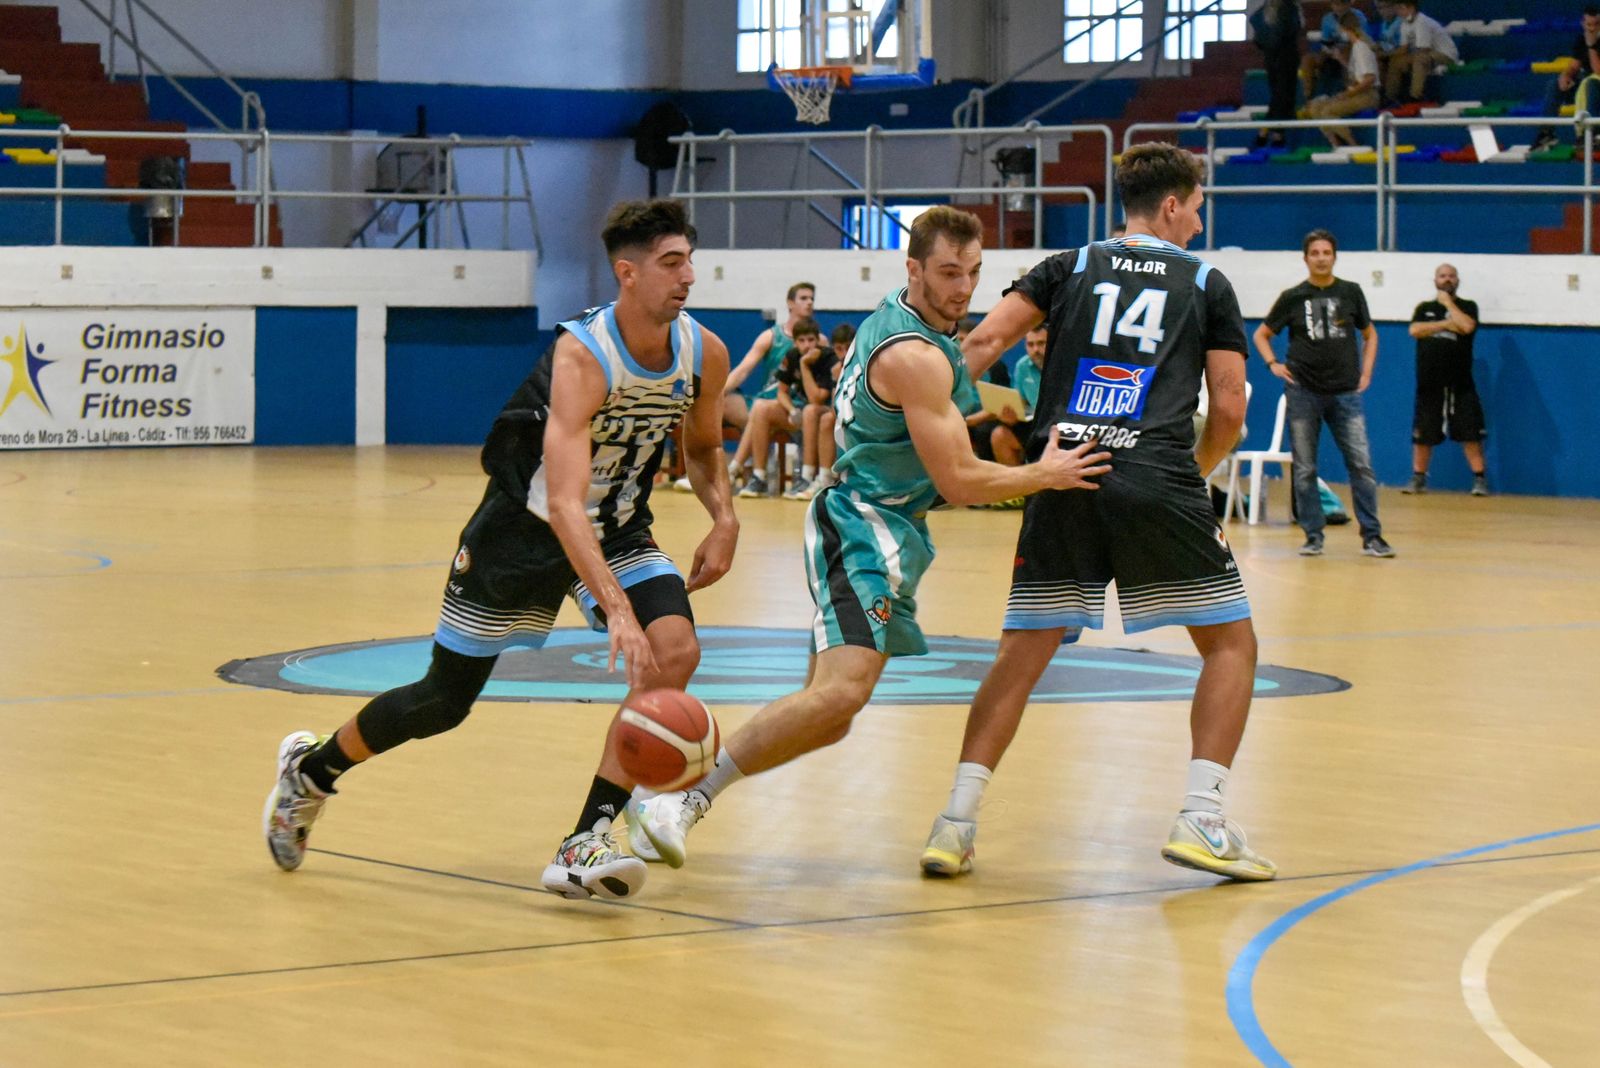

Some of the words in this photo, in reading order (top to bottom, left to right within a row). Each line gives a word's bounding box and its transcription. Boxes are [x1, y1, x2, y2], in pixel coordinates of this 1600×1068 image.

[1112, 256, 1167, 275] VALOR
[1091, 282, 1168, 354] 14
[81, 322, 225, 349] Gimnasio
[81, 358, 177, 384] Forma
[81, 392, 192, 419] Fitness
[1076, 385, 1141, 415] UBAGO
[23, 430, 35, 444] de
[39, 429, 63, 444] Mora
[66, 429, 78, 443] 29
[87, 428, 100, 442] La
[193, 426, 210, 440] 956
